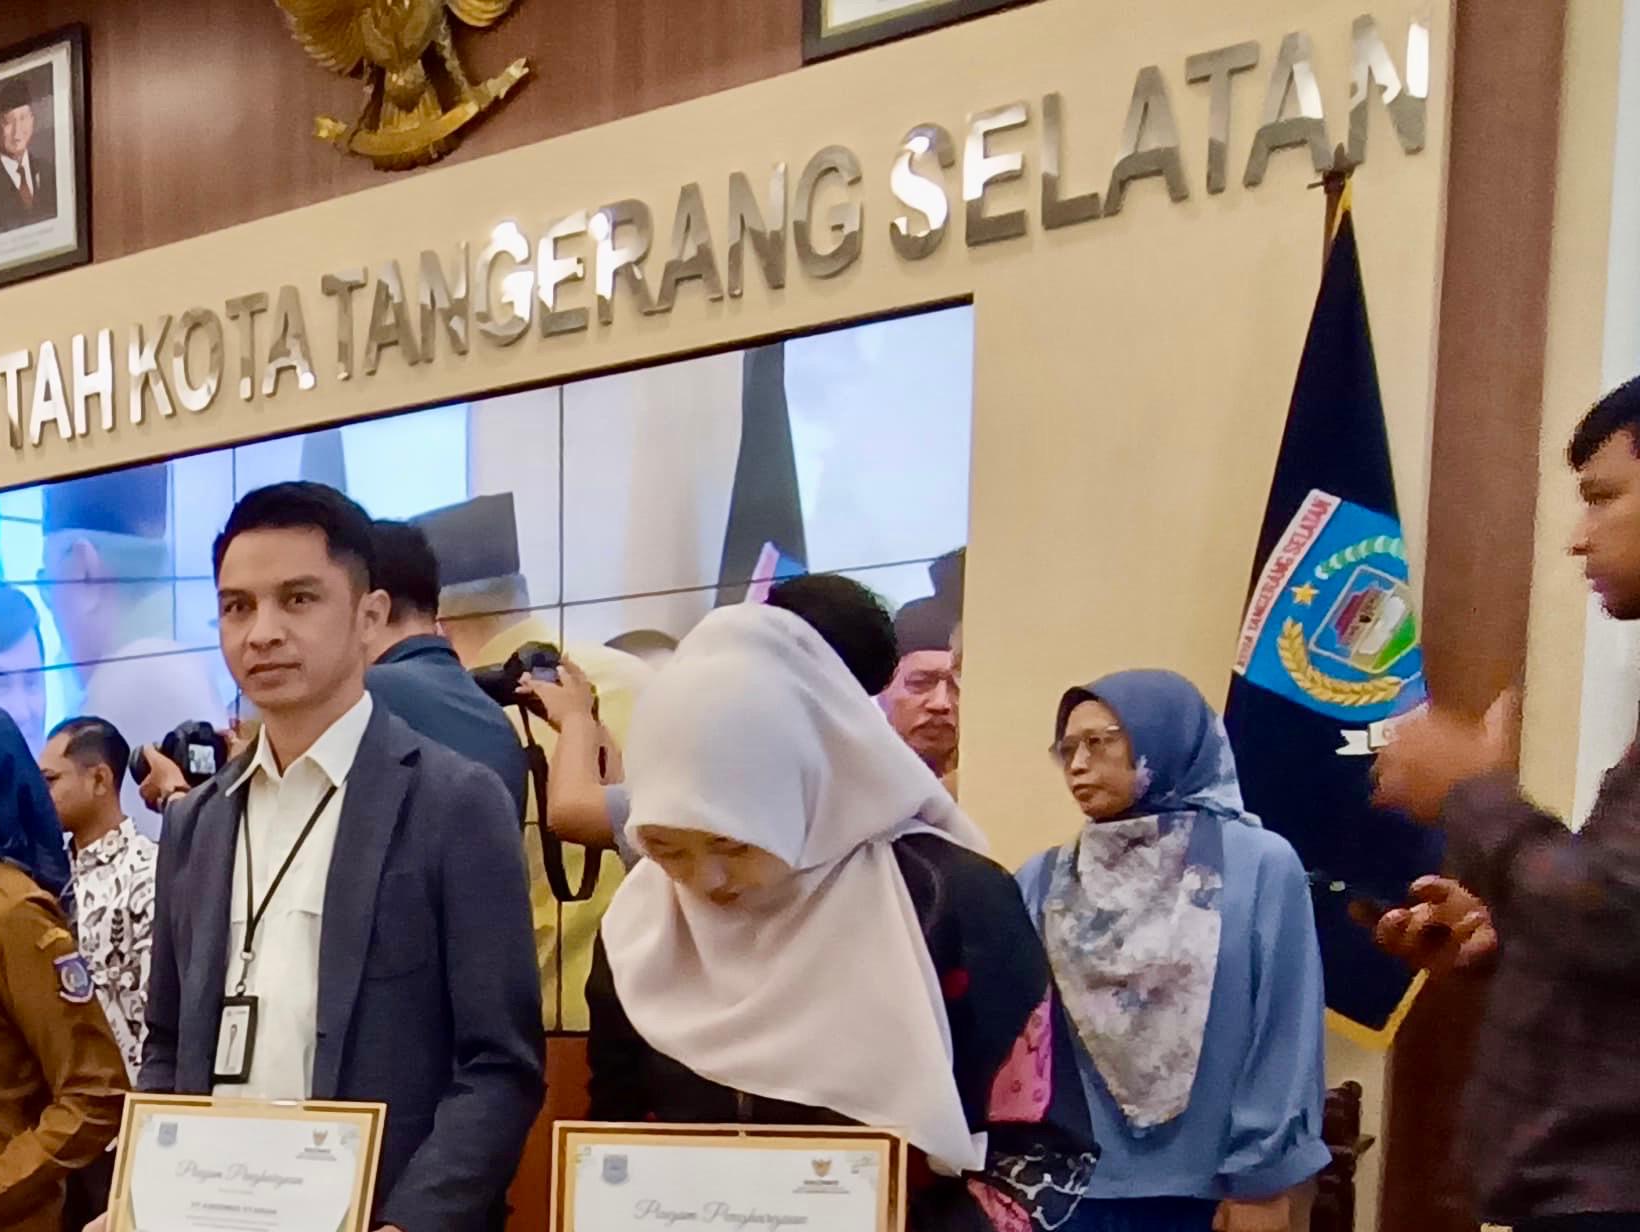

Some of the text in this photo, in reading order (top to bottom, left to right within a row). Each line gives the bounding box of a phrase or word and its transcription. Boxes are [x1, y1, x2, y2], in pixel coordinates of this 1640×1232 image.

[128, 283, 317, 427] KOTA
[321, 143, 864, 383] TANGERANG
[889, 13, 1432, 262] SELATAN
[1283, 495, 1332, 554] SELATAN
